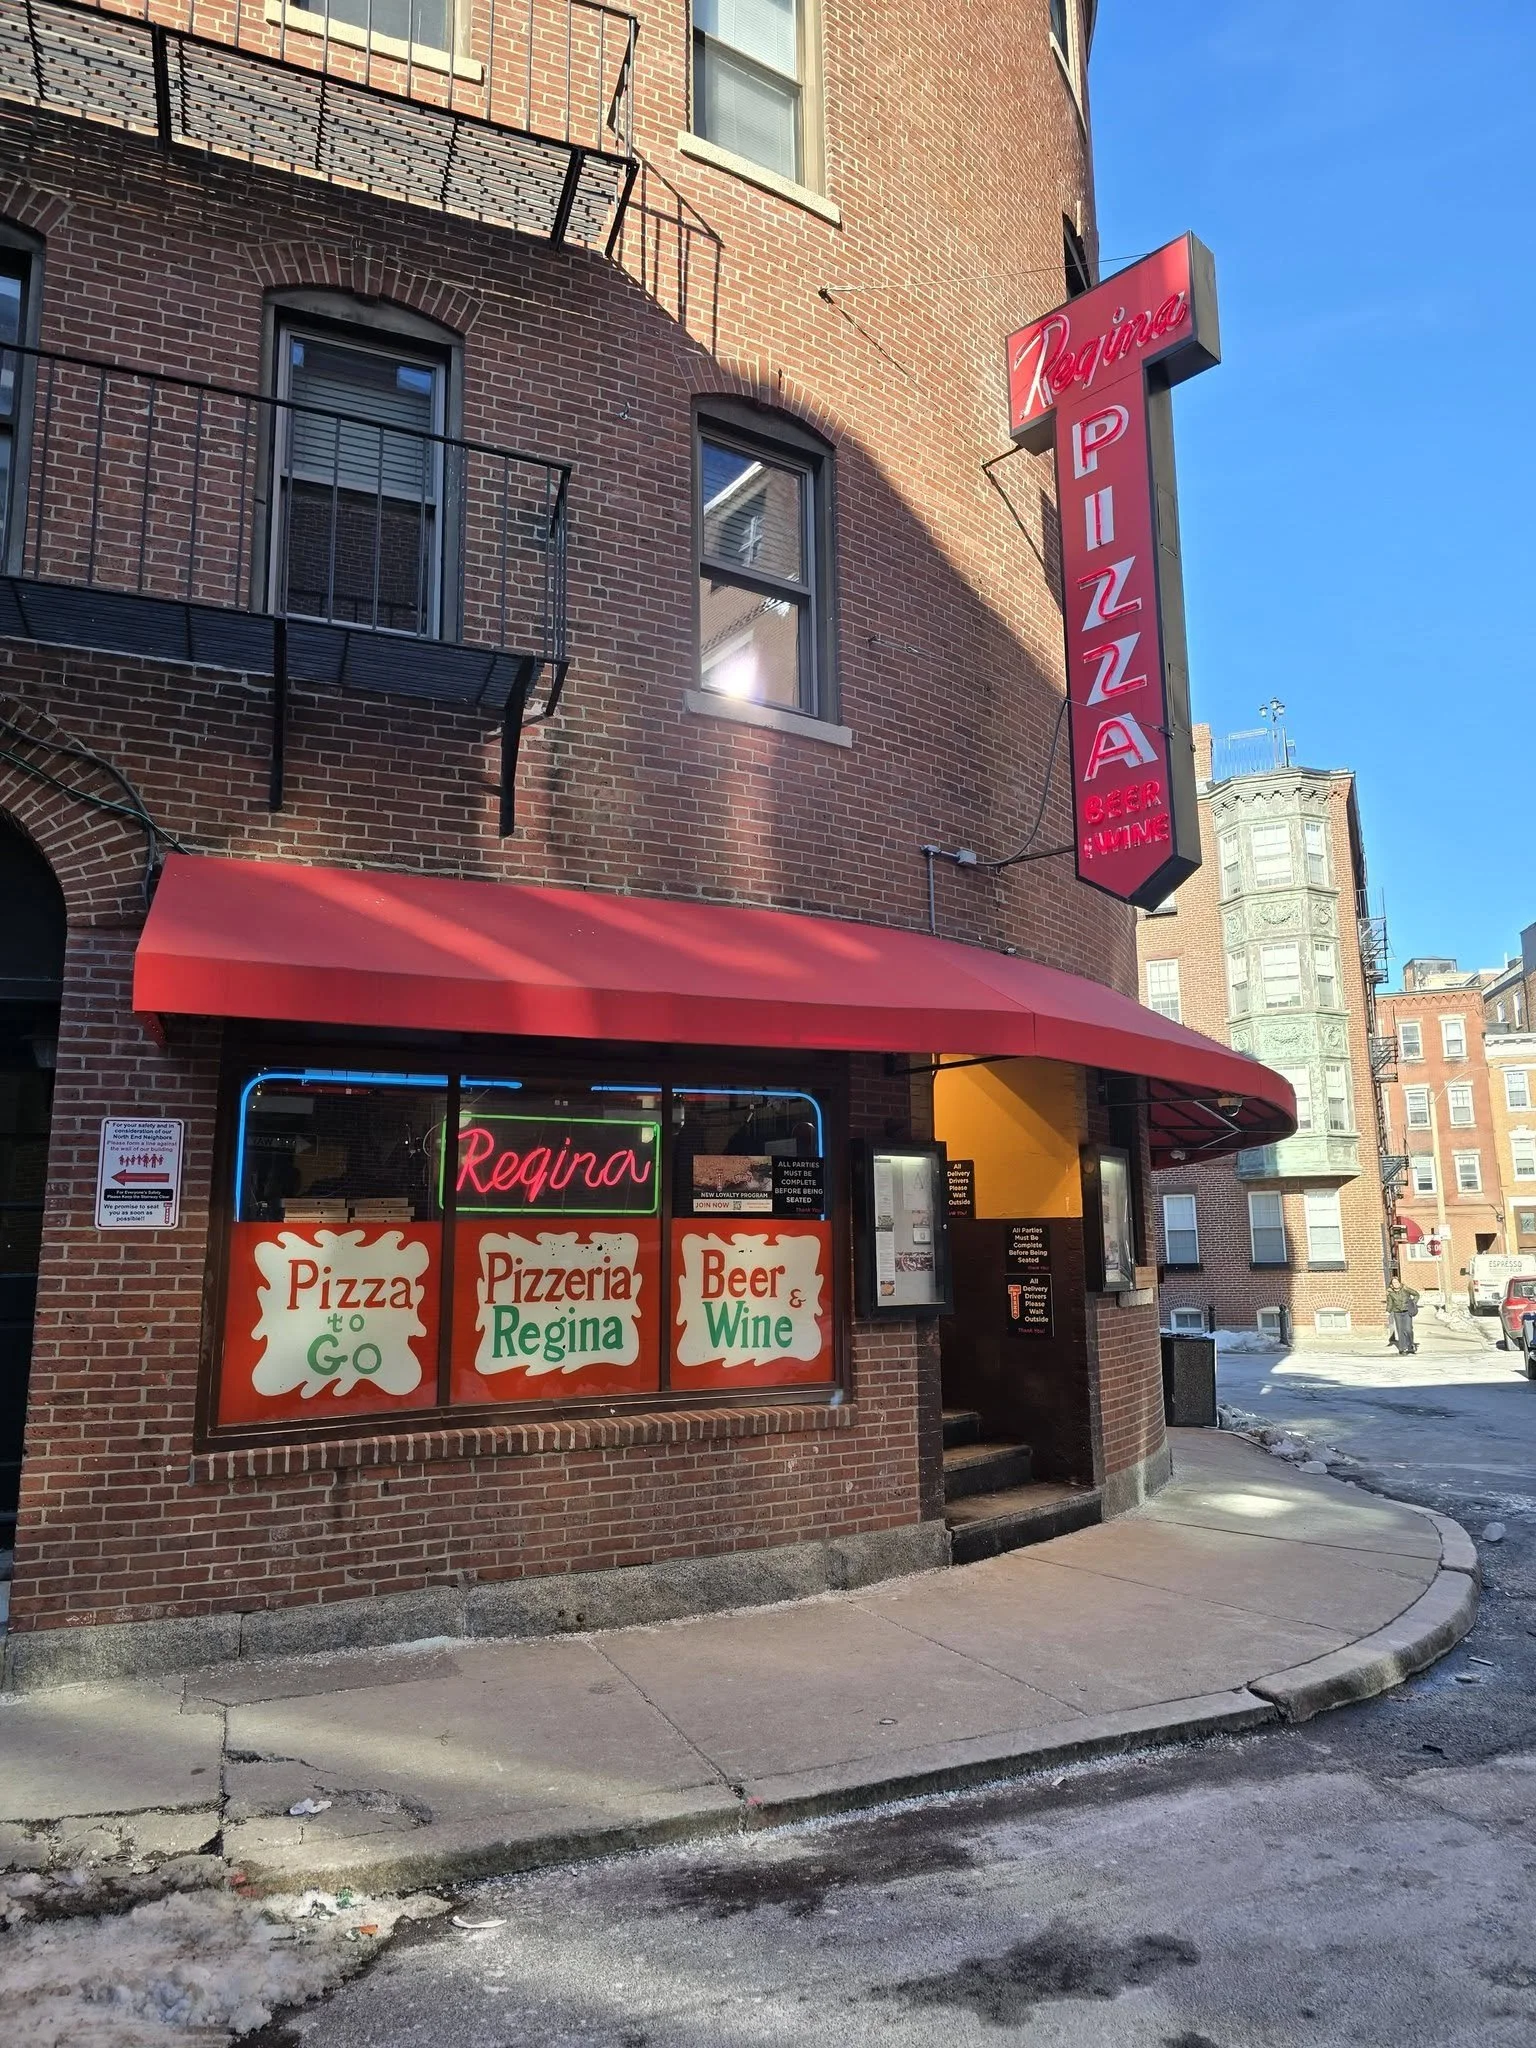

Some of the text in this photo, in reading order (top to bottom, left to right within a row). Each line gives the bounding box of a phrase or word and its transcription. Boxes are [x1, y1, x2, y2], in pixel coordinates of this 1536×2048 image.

[1013, 291, 1188, 417] Regina
[1072, 404, 1159, 782] PIZZA
[1084, 781, 1162, 824] BEER
[1094, 812, 1169, 855] WINE
[456, 1127, 652, 1203] Regina
[785, 1196, 812, 1204] SEATED
[1017, 1256, 1040, 1264] Seated
[1030, 1249, 1048, 1257] Being
[1488, 1260, 1523, 1268] ESPRESSO
[286, 1259, 414, 1311] Pizza
[484, 1252, 633, 1305] Pizzeria
[701, 1249, 807, 1309] Beer &
[1022, 1285, 1049, 1293] Delivery
[327, 1312, 365, 1333] to
[492, 1304, 624, 1363] Regina
[702, 1300, 793, 1349] Wine
